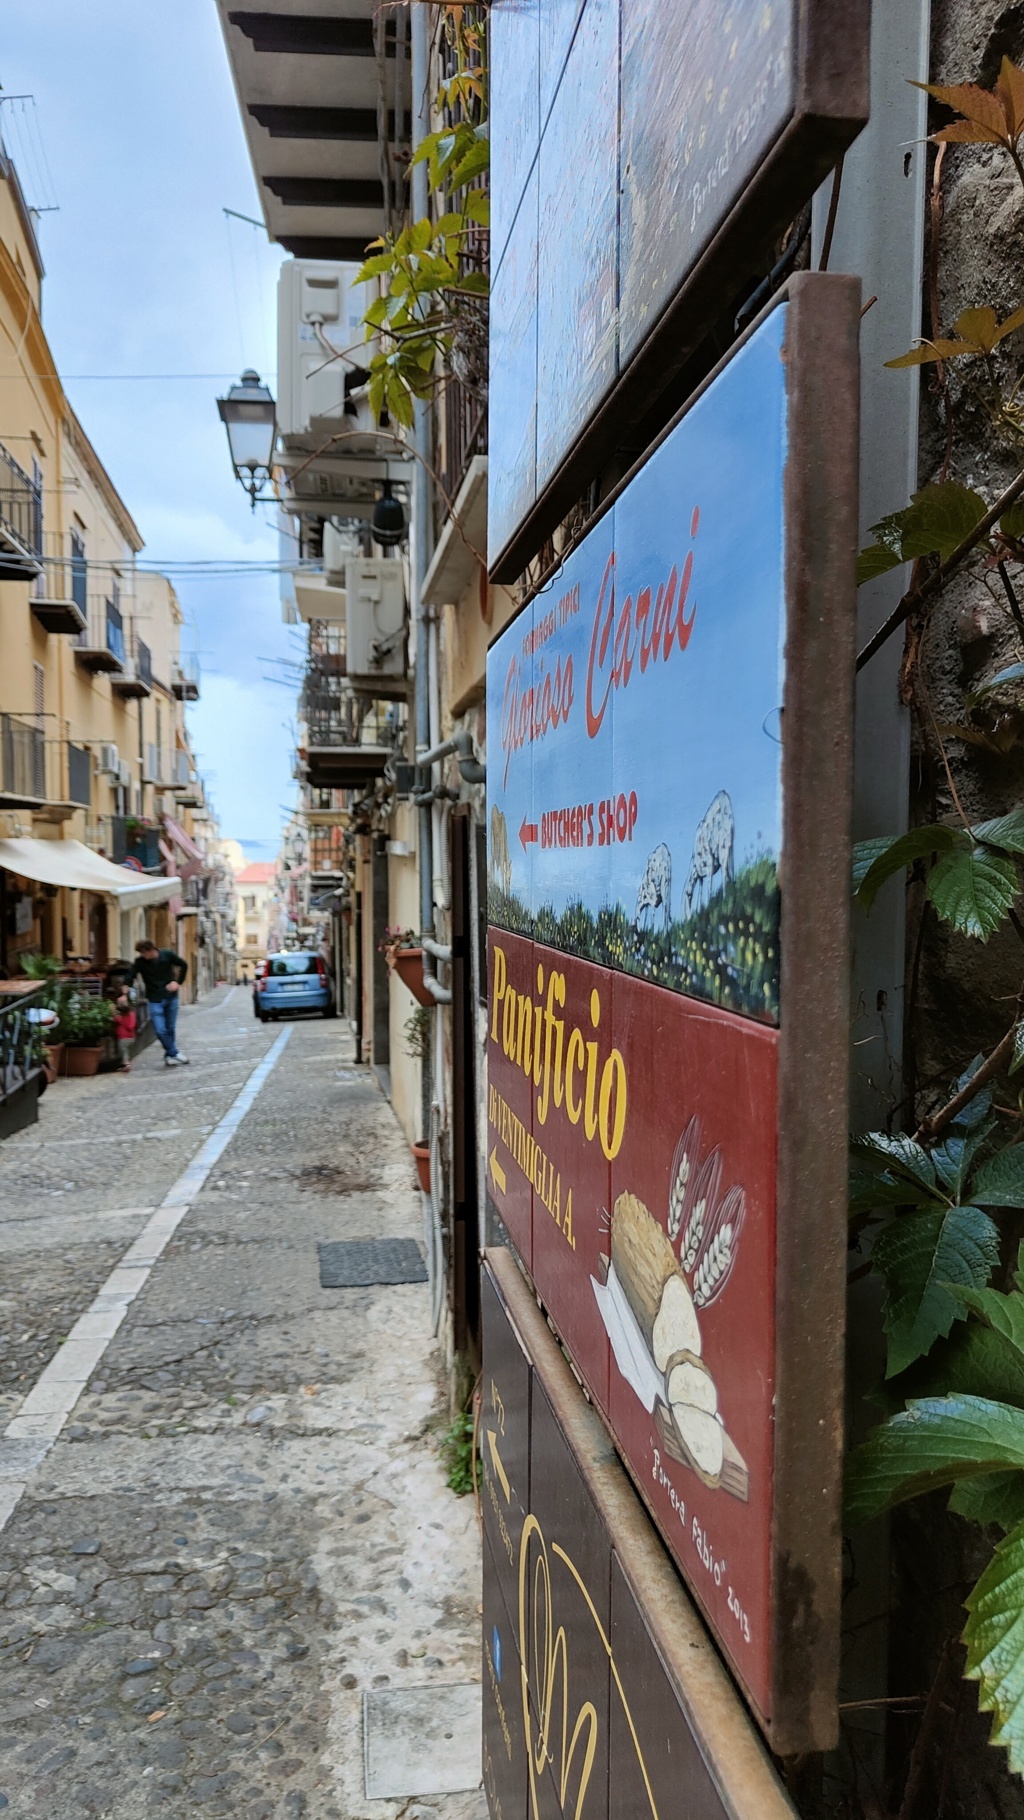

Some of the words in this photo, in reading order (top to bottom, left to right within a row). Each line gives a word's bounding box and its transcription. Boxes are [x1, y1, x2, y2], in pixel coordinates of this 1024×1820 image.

[502, 652, 574, 792] Glorioso
[586, 505, 700, 739] Carni
[522, 605, 557, 659] FORMAGGI
[558, 580, 580, 628] TIPICI
[541, 802, 594, 850] BUTCHER'S
[599, 790, 638, 846] SHOP
[490, 945, 627, 1161] Panificio
[497, 1092, 561, 1228] VENTIMIGLIA
[726, 1585, 751, 1644] 2013
